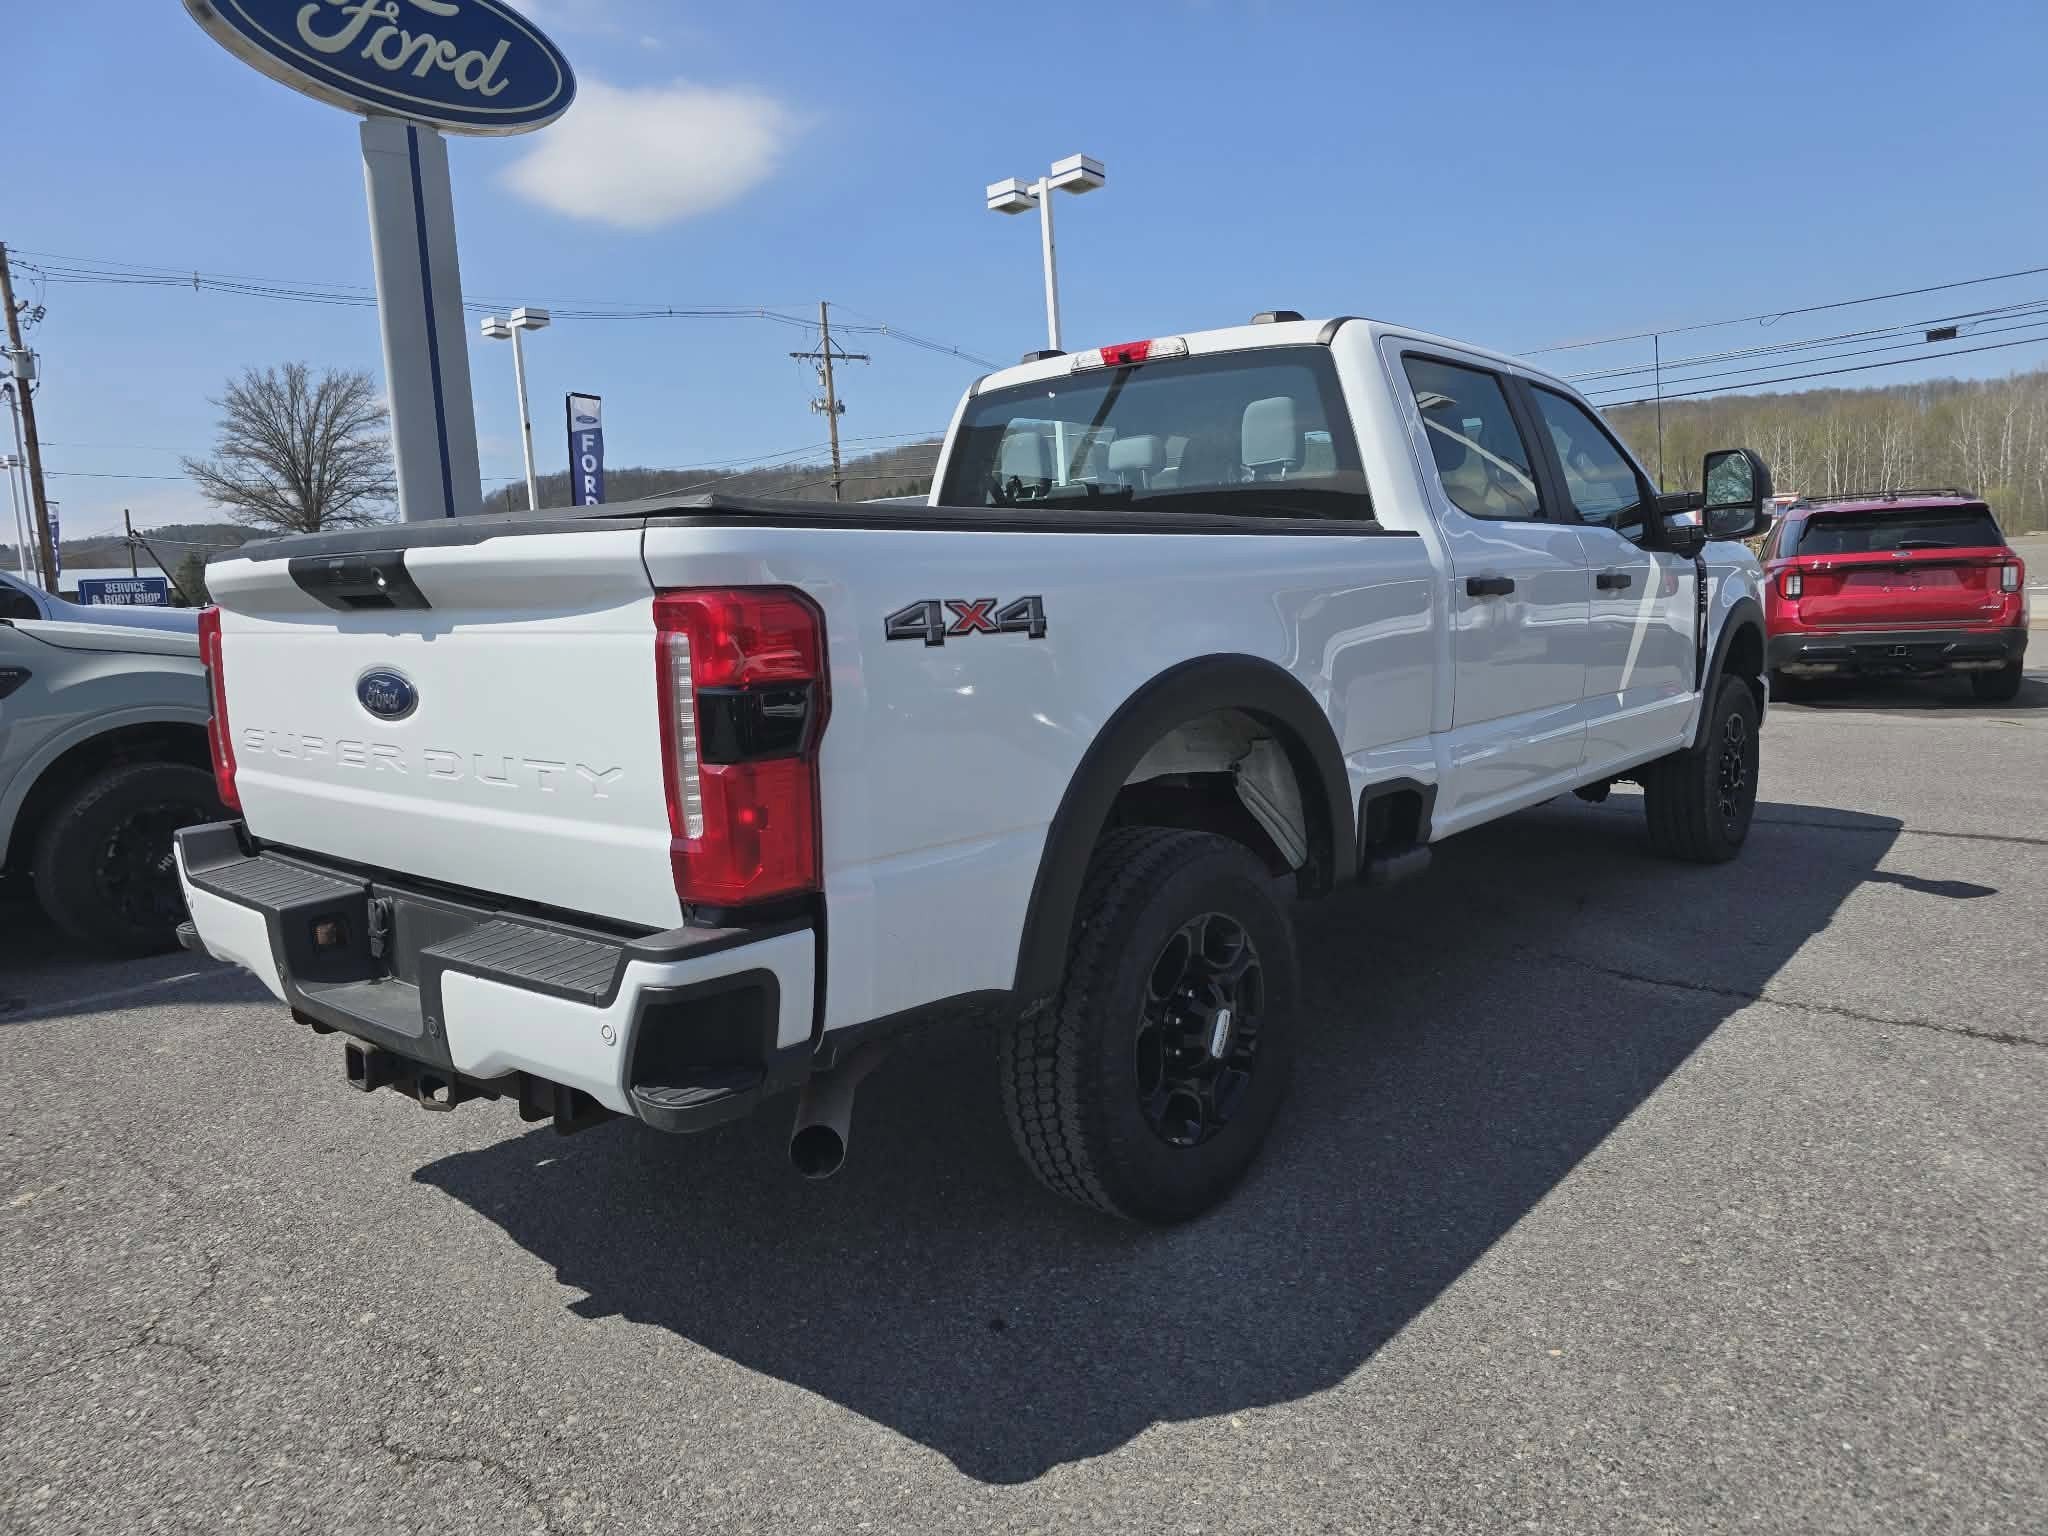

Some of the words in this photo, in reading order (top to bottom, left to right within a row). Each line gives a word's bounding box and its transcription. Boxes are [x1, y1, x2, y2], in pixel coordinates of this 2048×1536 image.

[297, 0, 511, 97] Ford
[104, 582, 145, 594] SERVICE
[104, 593, 131, 605] BODY
[134, 592, 161, 604] SHOP
[366, 679, 400, 709] Ford
[243, 727, 409, 776] SUPER
[423, 747, 624, 800] DUTY
